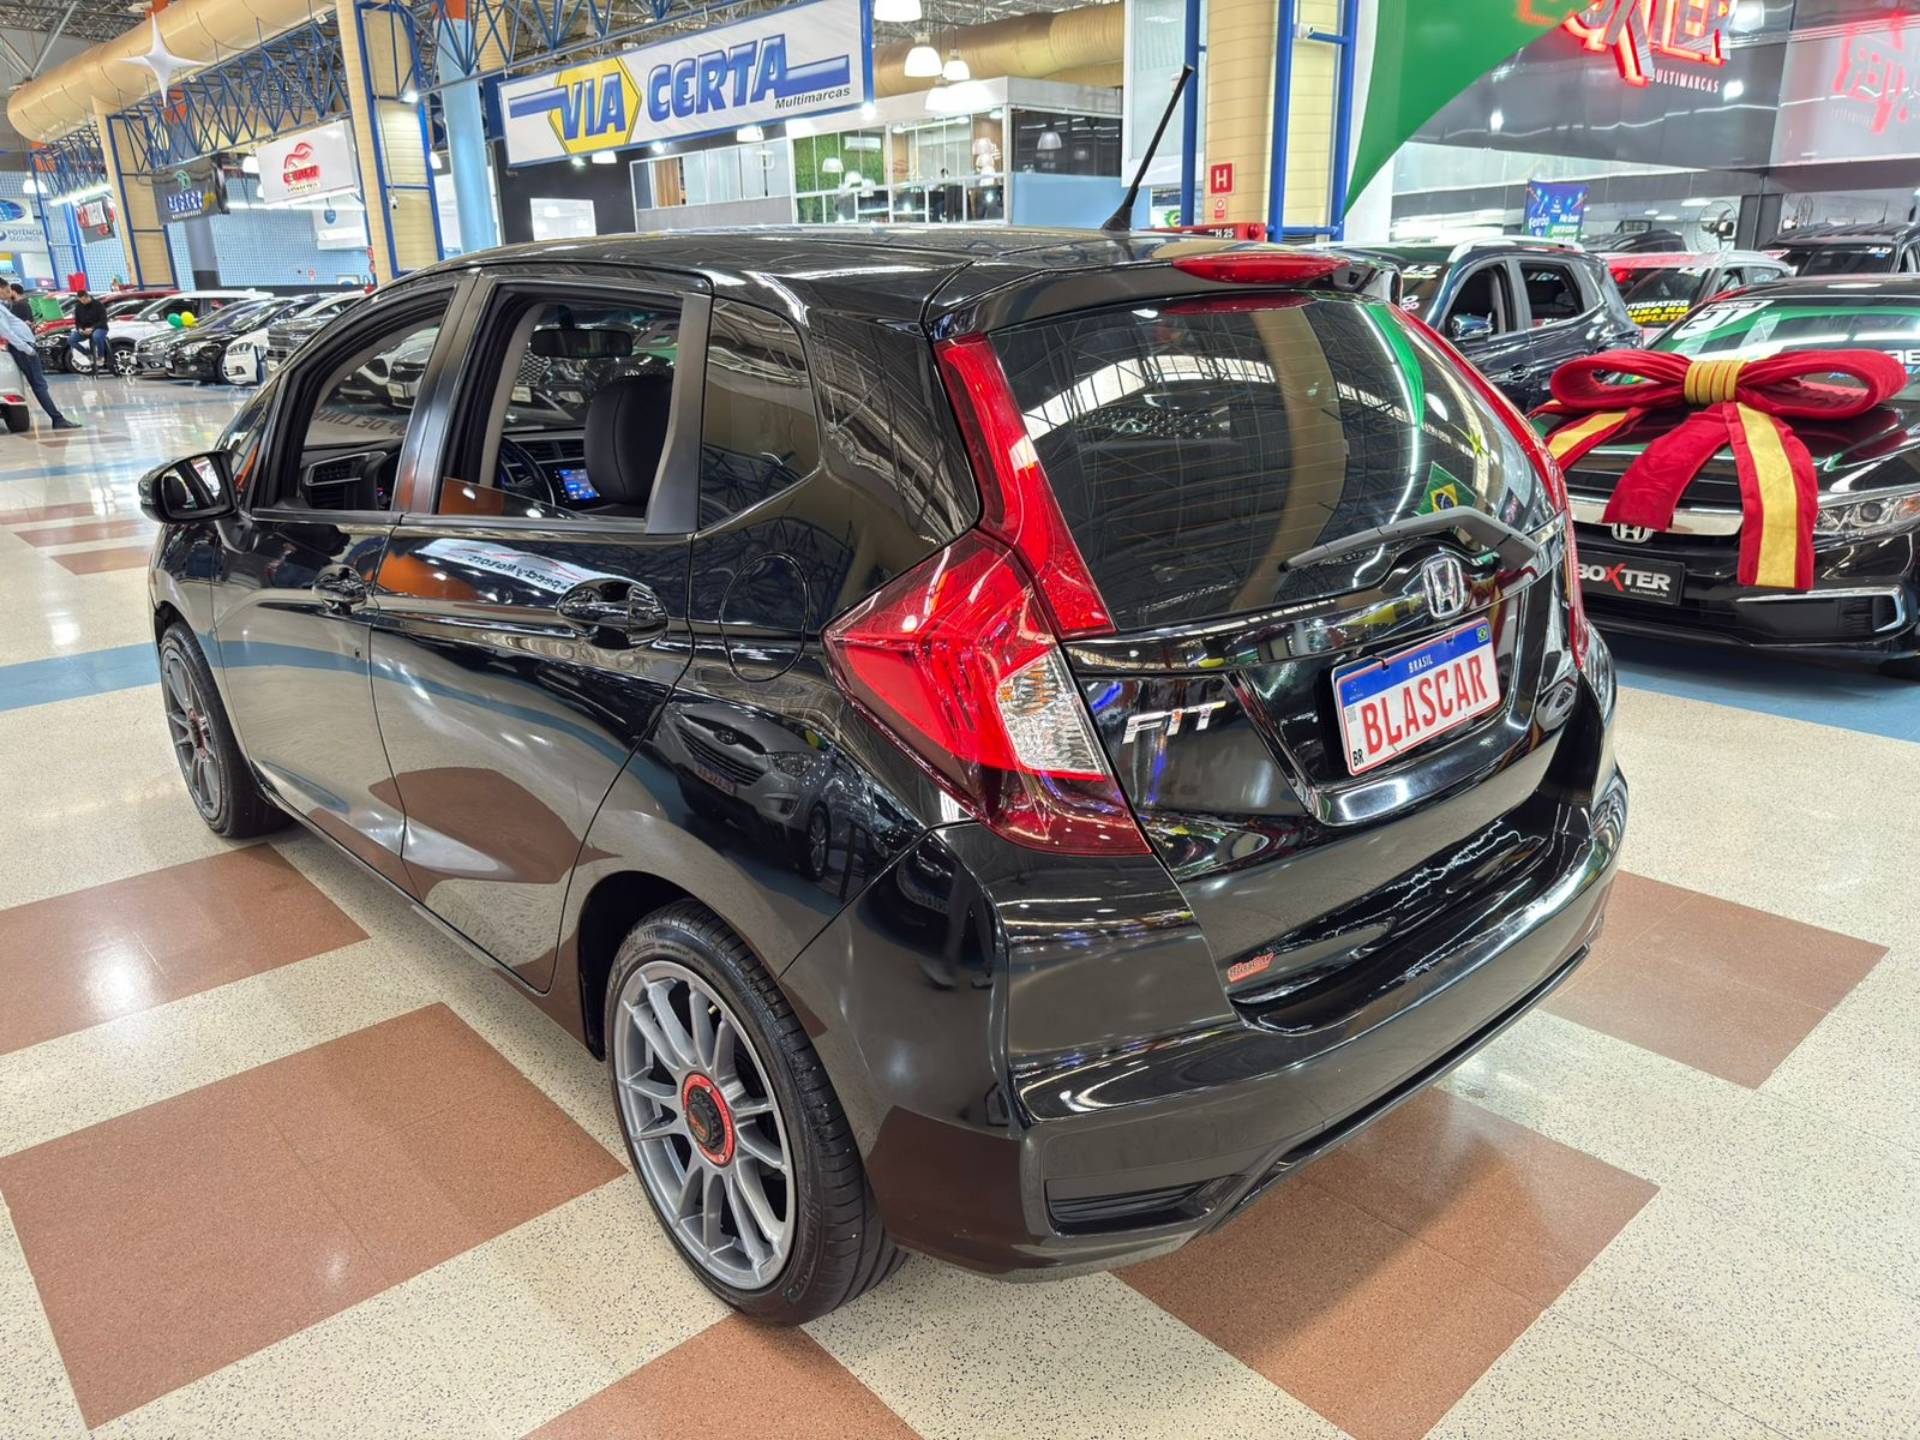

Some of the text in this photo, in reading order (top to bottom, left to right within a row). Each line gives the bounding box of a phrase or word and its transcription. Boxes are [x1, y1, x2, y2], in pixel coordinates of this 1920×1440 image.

[560, 33, 789, 141] VIA CERTA
[1655, 69, 1719, 93] ULTIMARCAS
[775, 86, 851, 110] Multimarcas
[1215, 168, 1228, 190] H
[1625, 299, 1690, 310] UTOMATICO
[1408, 654, 1433, 673] BRASIL
[1360, 654, 1488, 756] BLASCAR
[1121, 700, 1227, 745] FIT
[1352, 748, 1365, 767] BR
